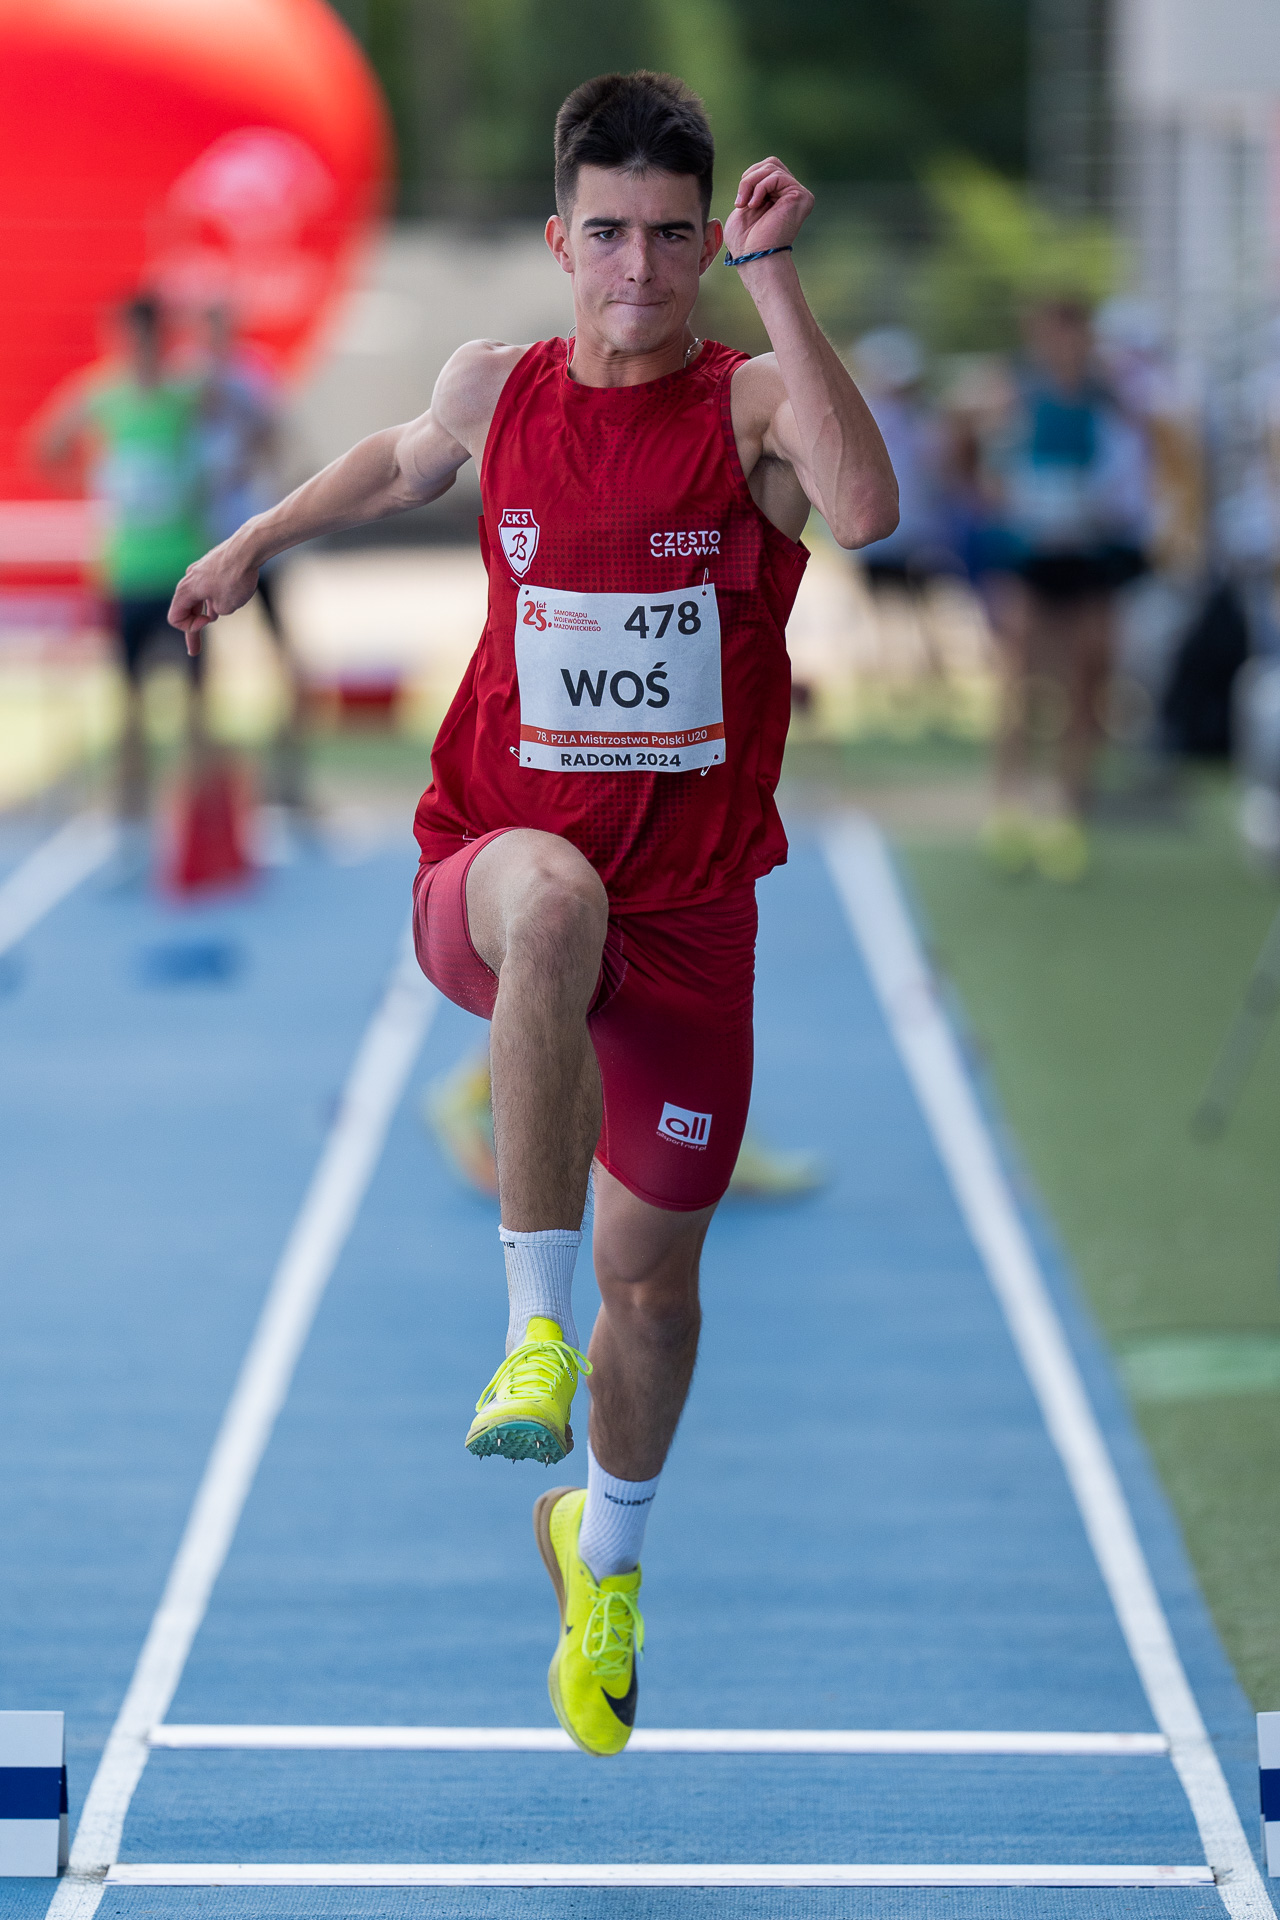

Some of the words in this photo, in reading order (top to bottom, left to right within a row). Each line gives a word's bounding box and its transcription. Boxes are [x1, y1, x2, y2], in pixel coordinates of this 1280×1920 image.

[506, 513, 528, 525] CKS
[536, 601, 547, 609] lat
[554, 609, 588, 619] SAMORZĄDU
[624, 601, 701, 639] 478
[554, 616, 599, 626] WOJEWÓDZTWA
[554, 623, 602, 632] MAZOWIECKIEGO
[560, 661, 671, 709] WOŚ
[536, 730, 549, 743] 78.
[551, 734, 577, 744] PZLA
[580, 734, 649, 745] Mistrzostwa
[651, 734, 685, 745] Polski
[687, 729, 708, 742] U20
[561, 753, 632, 767] RADOM
[636, 752, 681, 767] 2024
